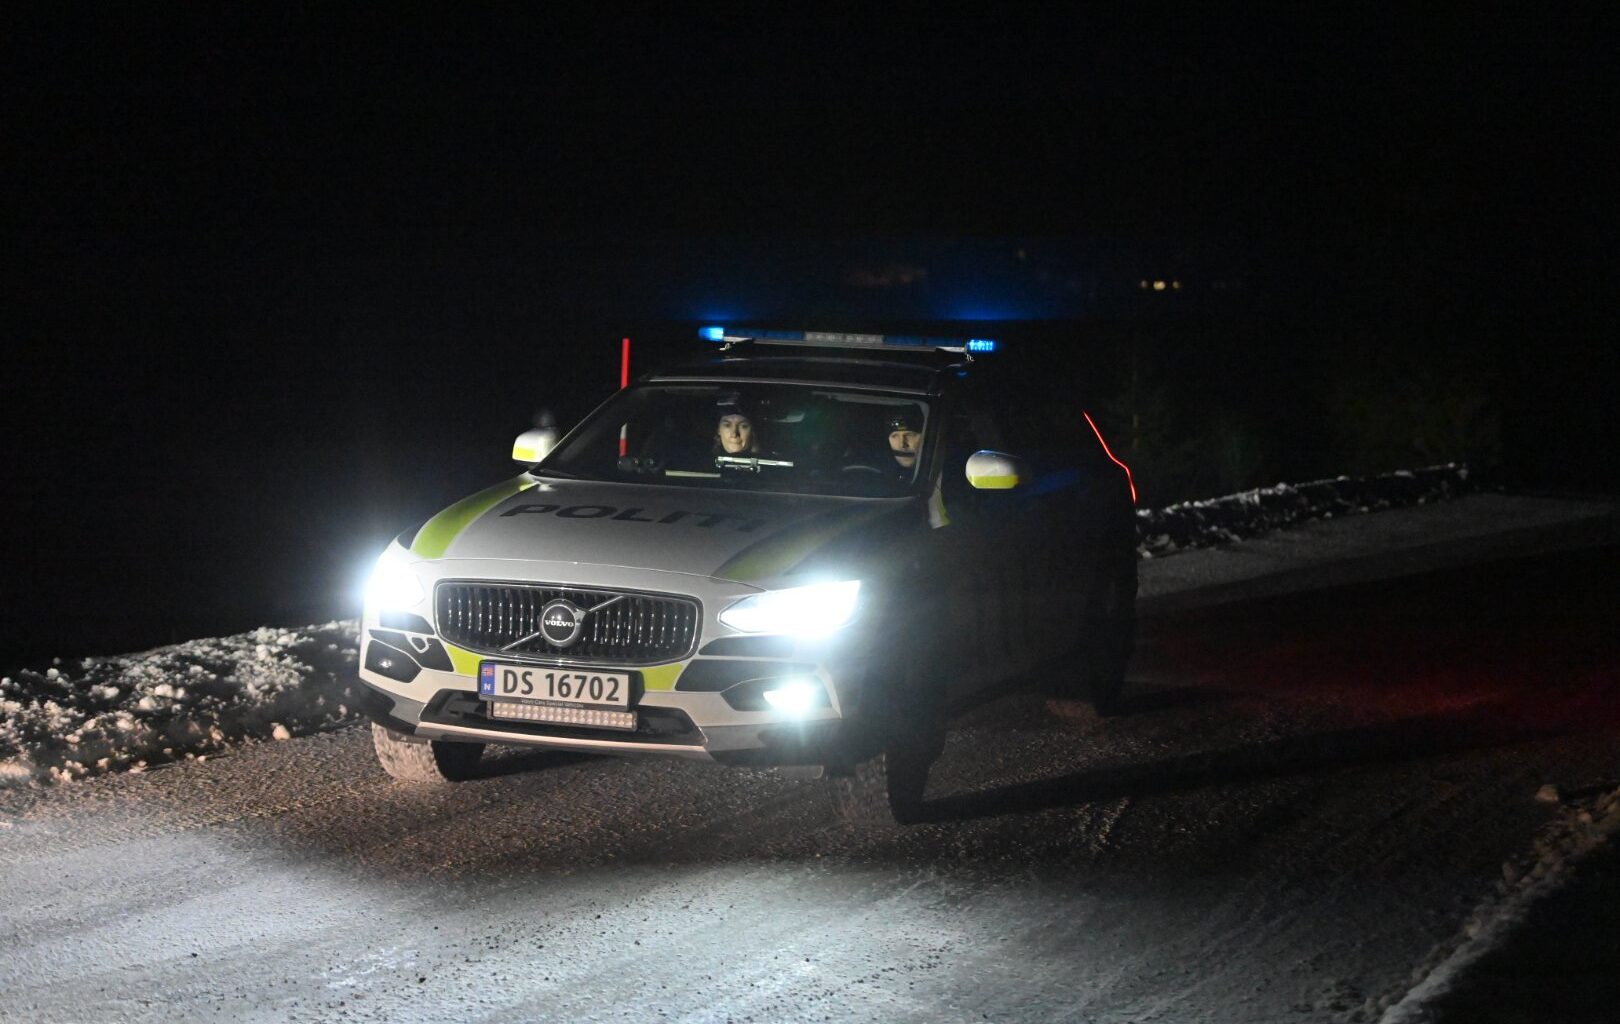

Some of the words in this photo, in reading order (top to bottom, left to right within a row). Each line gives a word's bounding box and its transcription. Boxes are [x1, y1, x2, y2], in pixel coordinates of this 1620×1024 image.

[500, 504, 766, 532] POLITI
[545, 620, 574, 628] VOLVO
[483, 683, 491, 691] N
[503, 669, 533, 695] DS
[545, 673, 619, 702] 16702
